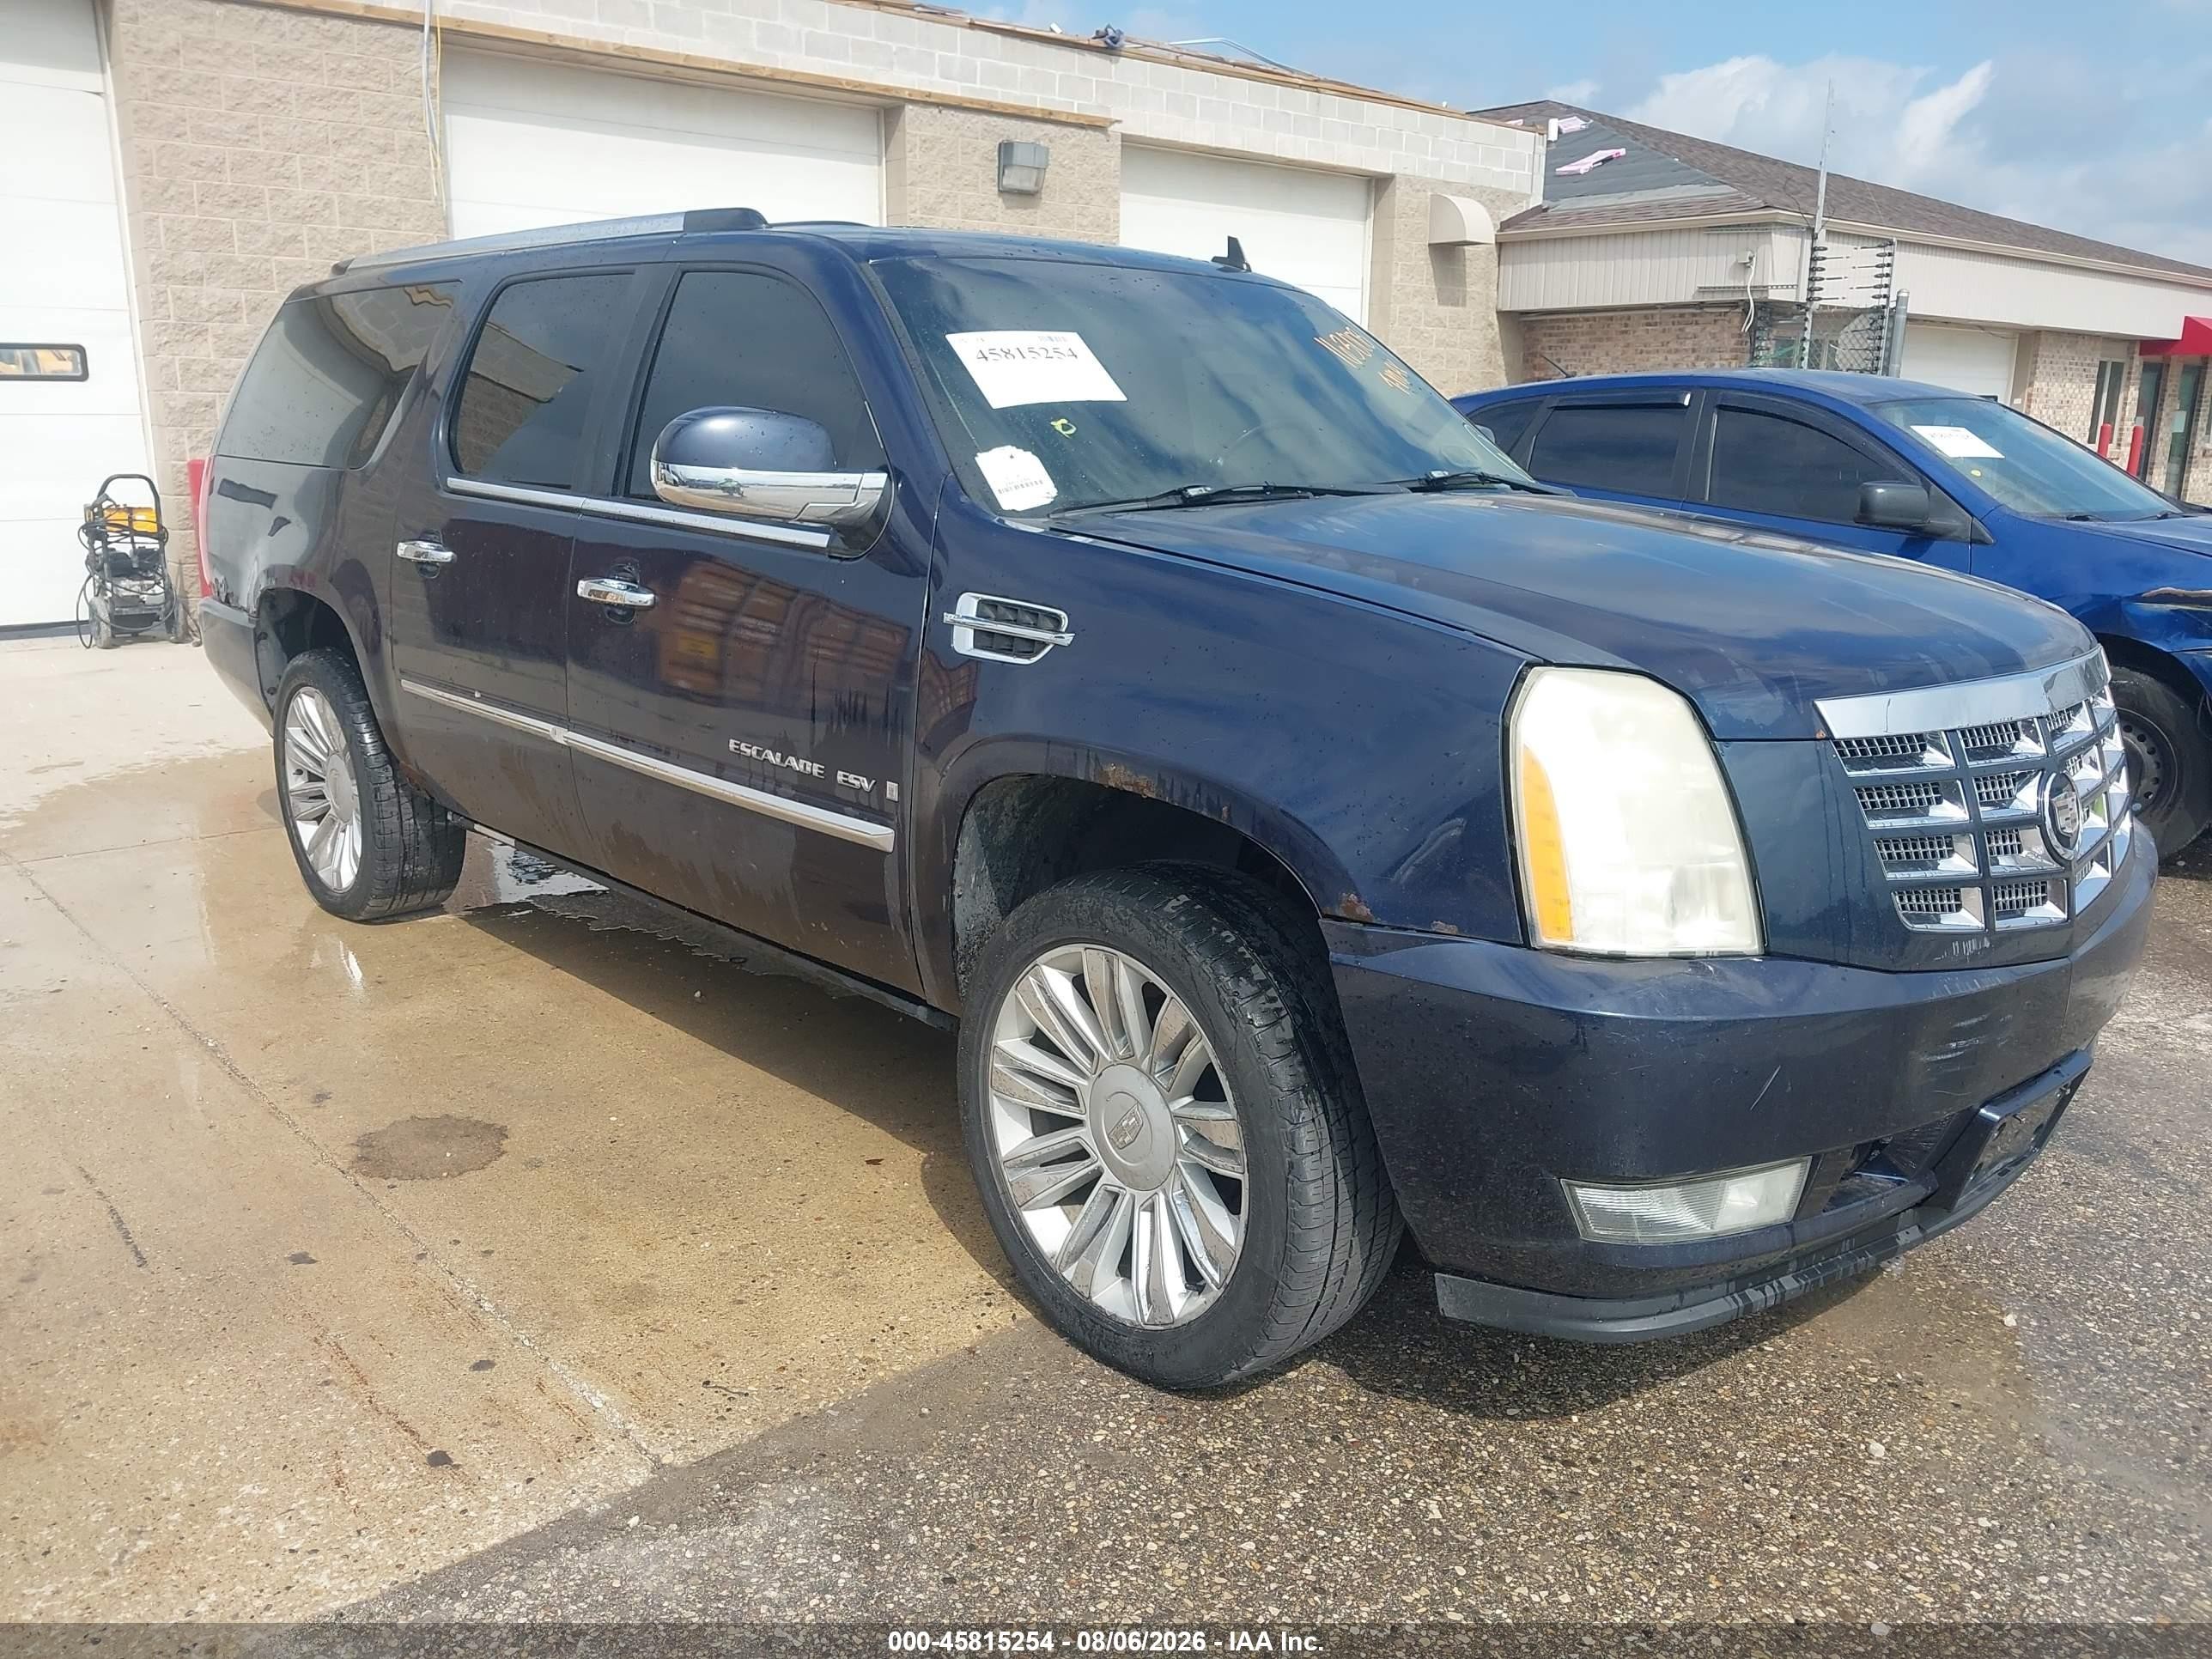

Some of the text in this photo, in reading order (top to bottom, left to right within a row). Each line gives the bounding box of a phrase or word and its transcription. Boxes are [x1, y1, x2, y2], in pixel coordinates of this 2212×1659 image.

[975, 347, 1079, 362] 45815254
[728, 738, 877, 793] ESCALADE ESV
